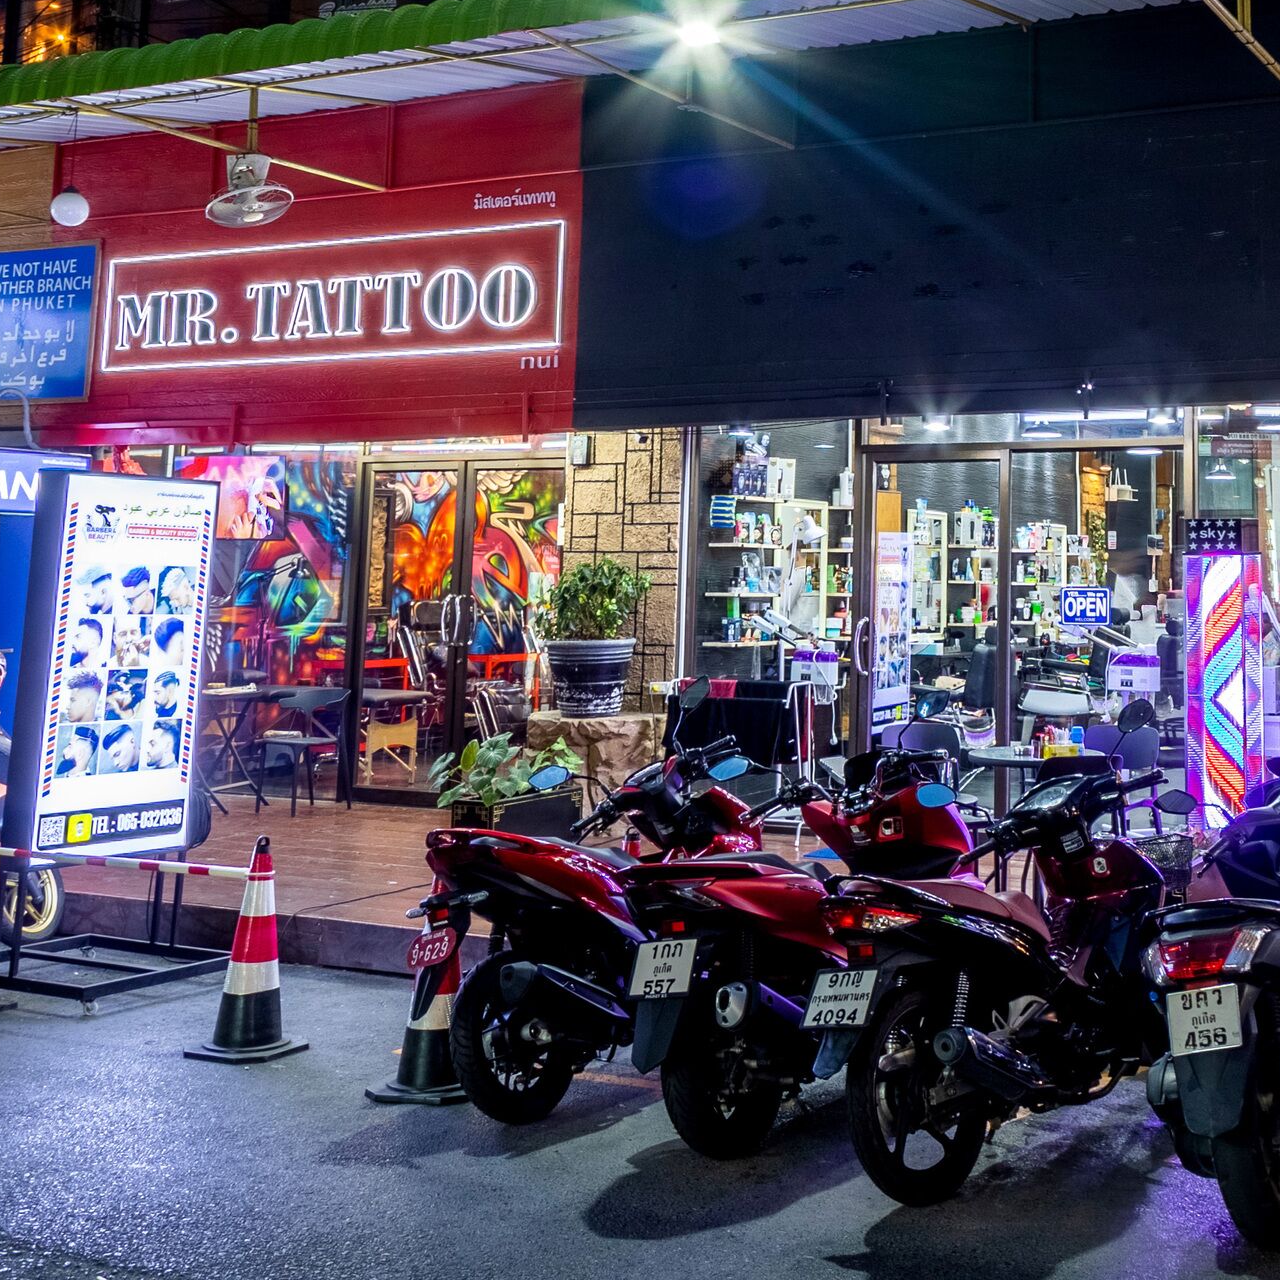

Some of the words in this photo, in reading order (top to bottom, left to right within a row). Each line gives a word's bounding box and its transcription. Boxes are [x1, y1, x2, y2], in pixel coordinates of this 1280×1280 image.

[12, 262, 40, 277] NOT
[43, 259, 77, 274] HAVE
[37, 275, 92, 293] BRANCH
[12, 294, 76, 312] PHUKET
[65, 319, 75, 343] لا
[37, 342, 67, 367] فرع
[520, 350, 559, 370] nui
[0, 371, 45, 389] بوكت
[1199, 528, 1226, 541] sky
[1064, 597, 1107, 617] OPEN
[653, 962, 672, 977] ภูเก็ต
[643, 978, 676, 995] 557
[812, 992, 870, 1007] กรุงเทพมหานคร
[812, 1008, 858, 1024] 4094
[1192, 1012, 1216, 1029] ภูเก็ต
[1185, 1027, 1227, 1050] 456
